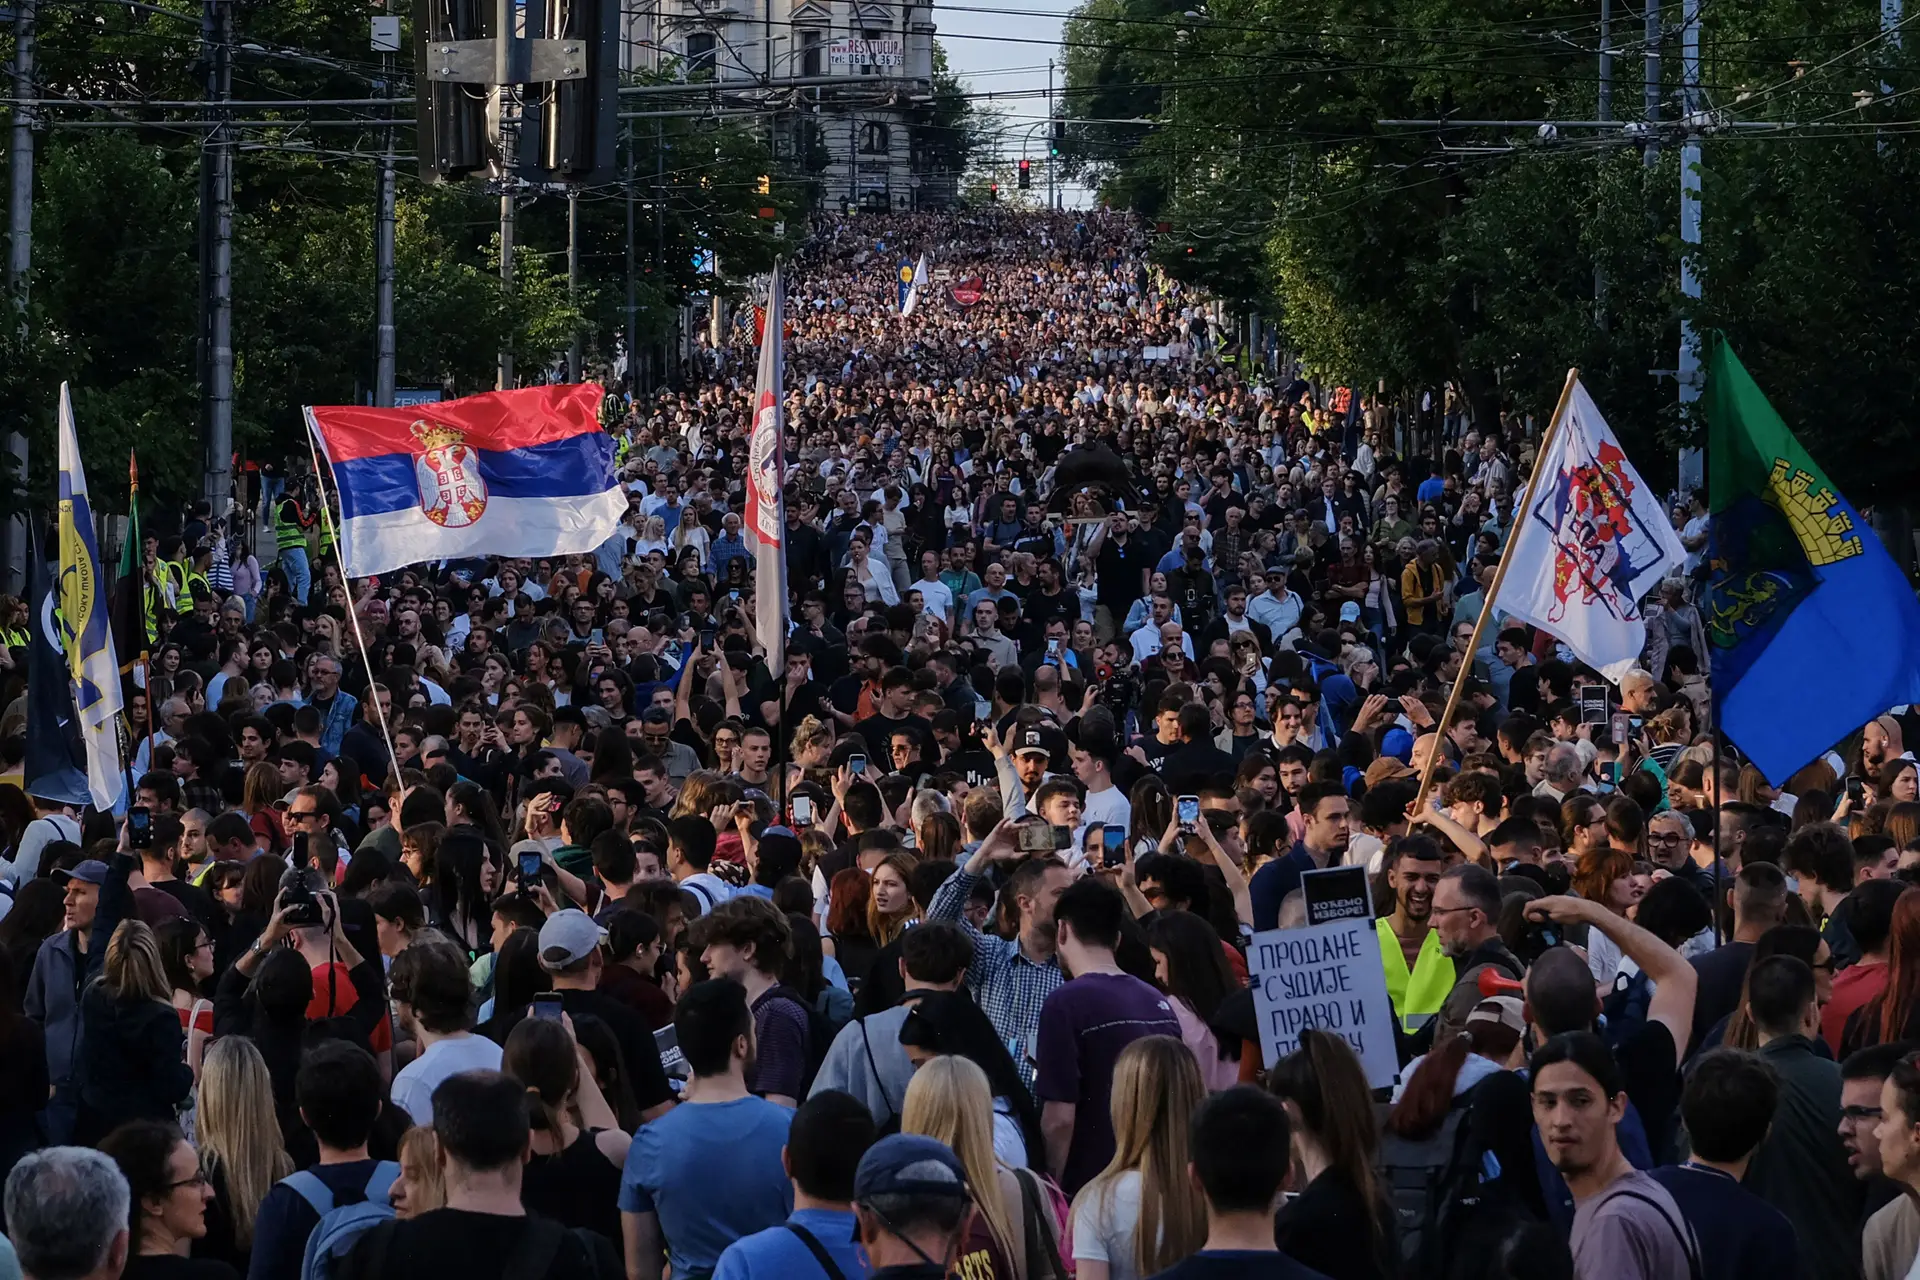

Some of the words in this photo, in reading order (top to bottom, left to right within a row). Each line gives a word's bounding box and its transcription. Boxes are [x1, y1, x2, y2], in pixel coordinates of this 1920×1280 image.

[1312, 897, 1363, 911] ХОЋЕМО
[1314, 906, 1364, 919] ИЗБОРЕ!
[1259, 930, 1362, 970] ПРОДАНЕ
[1265, 964, 1352, 1002] СУДИЈЕ
[1271, 1001, 1342, 1036] ПРАВО
[1350, 999, 1366, 1026] И
